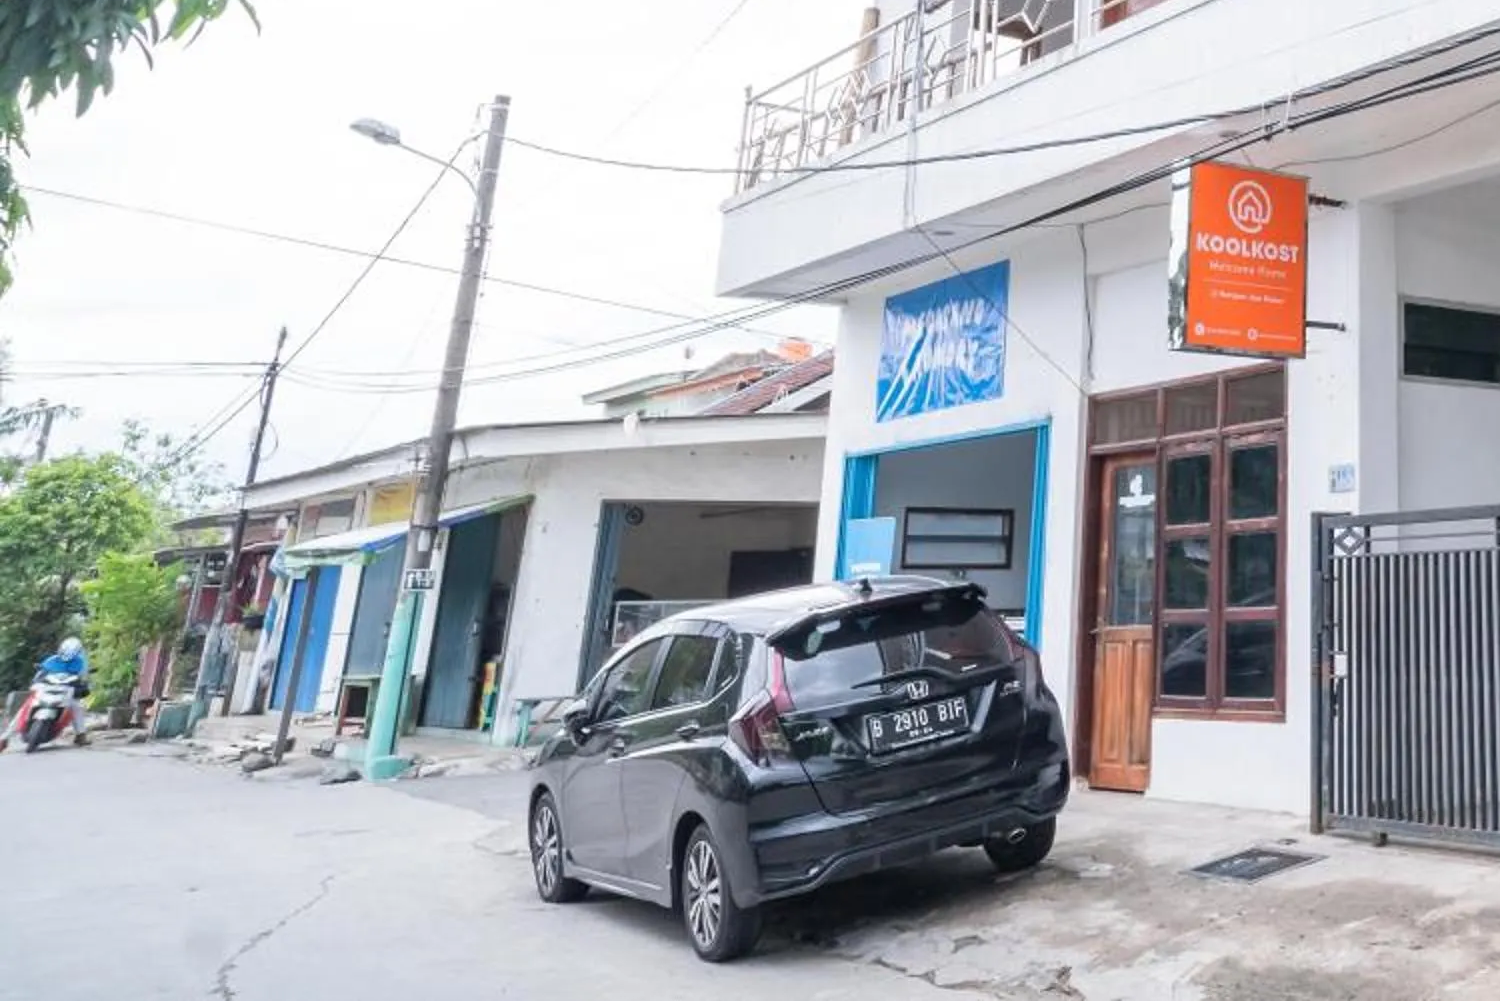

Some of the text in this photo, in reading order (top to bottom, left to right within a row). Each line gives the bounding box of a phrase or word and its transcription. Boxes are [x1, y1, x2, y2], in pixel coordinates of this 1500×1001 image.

[1196, 232, 1299, 263] KOOLKOST
[872, 719, 883, 738] B
[893, 708, 928, 732] 2910
[938, 700, 963, 722] BIF
